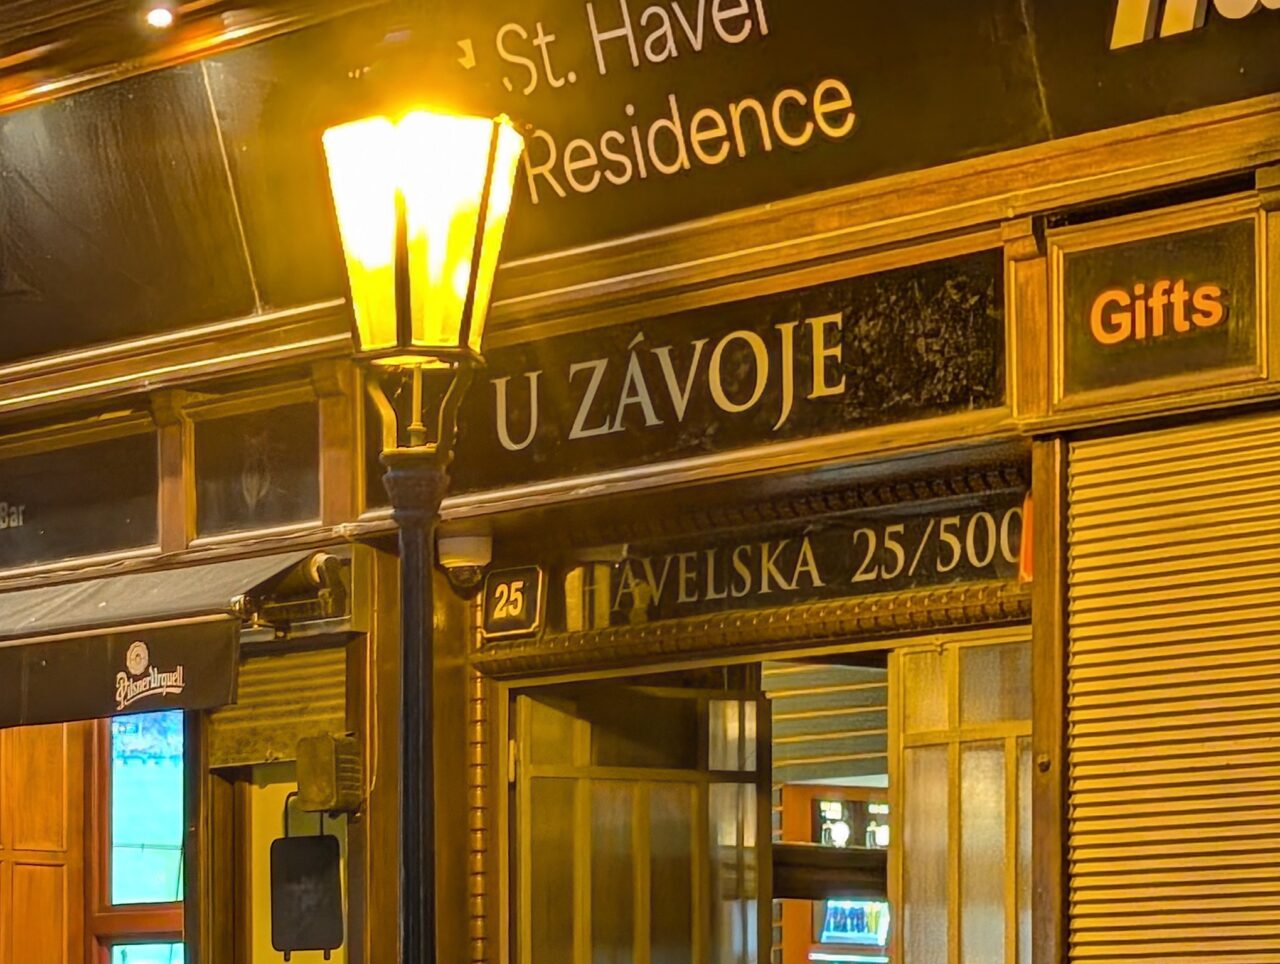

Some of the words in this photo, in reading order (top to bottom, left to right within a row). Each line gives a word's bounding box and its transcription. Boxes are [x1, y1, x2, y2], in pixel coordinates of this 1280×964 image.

[496, 21, 578, 95] St.
[524, 77, 856, 204] Residence
[1090, 278, 1223, 345] Gifts
[490, 370, 543, 451] U
[568, 312, 847, 440] ZÁVOJE
[493, 581, 524, 619] 25
[116, 671, 151, 710] Pilsner
[149, 665, 185, 696] Urquell
